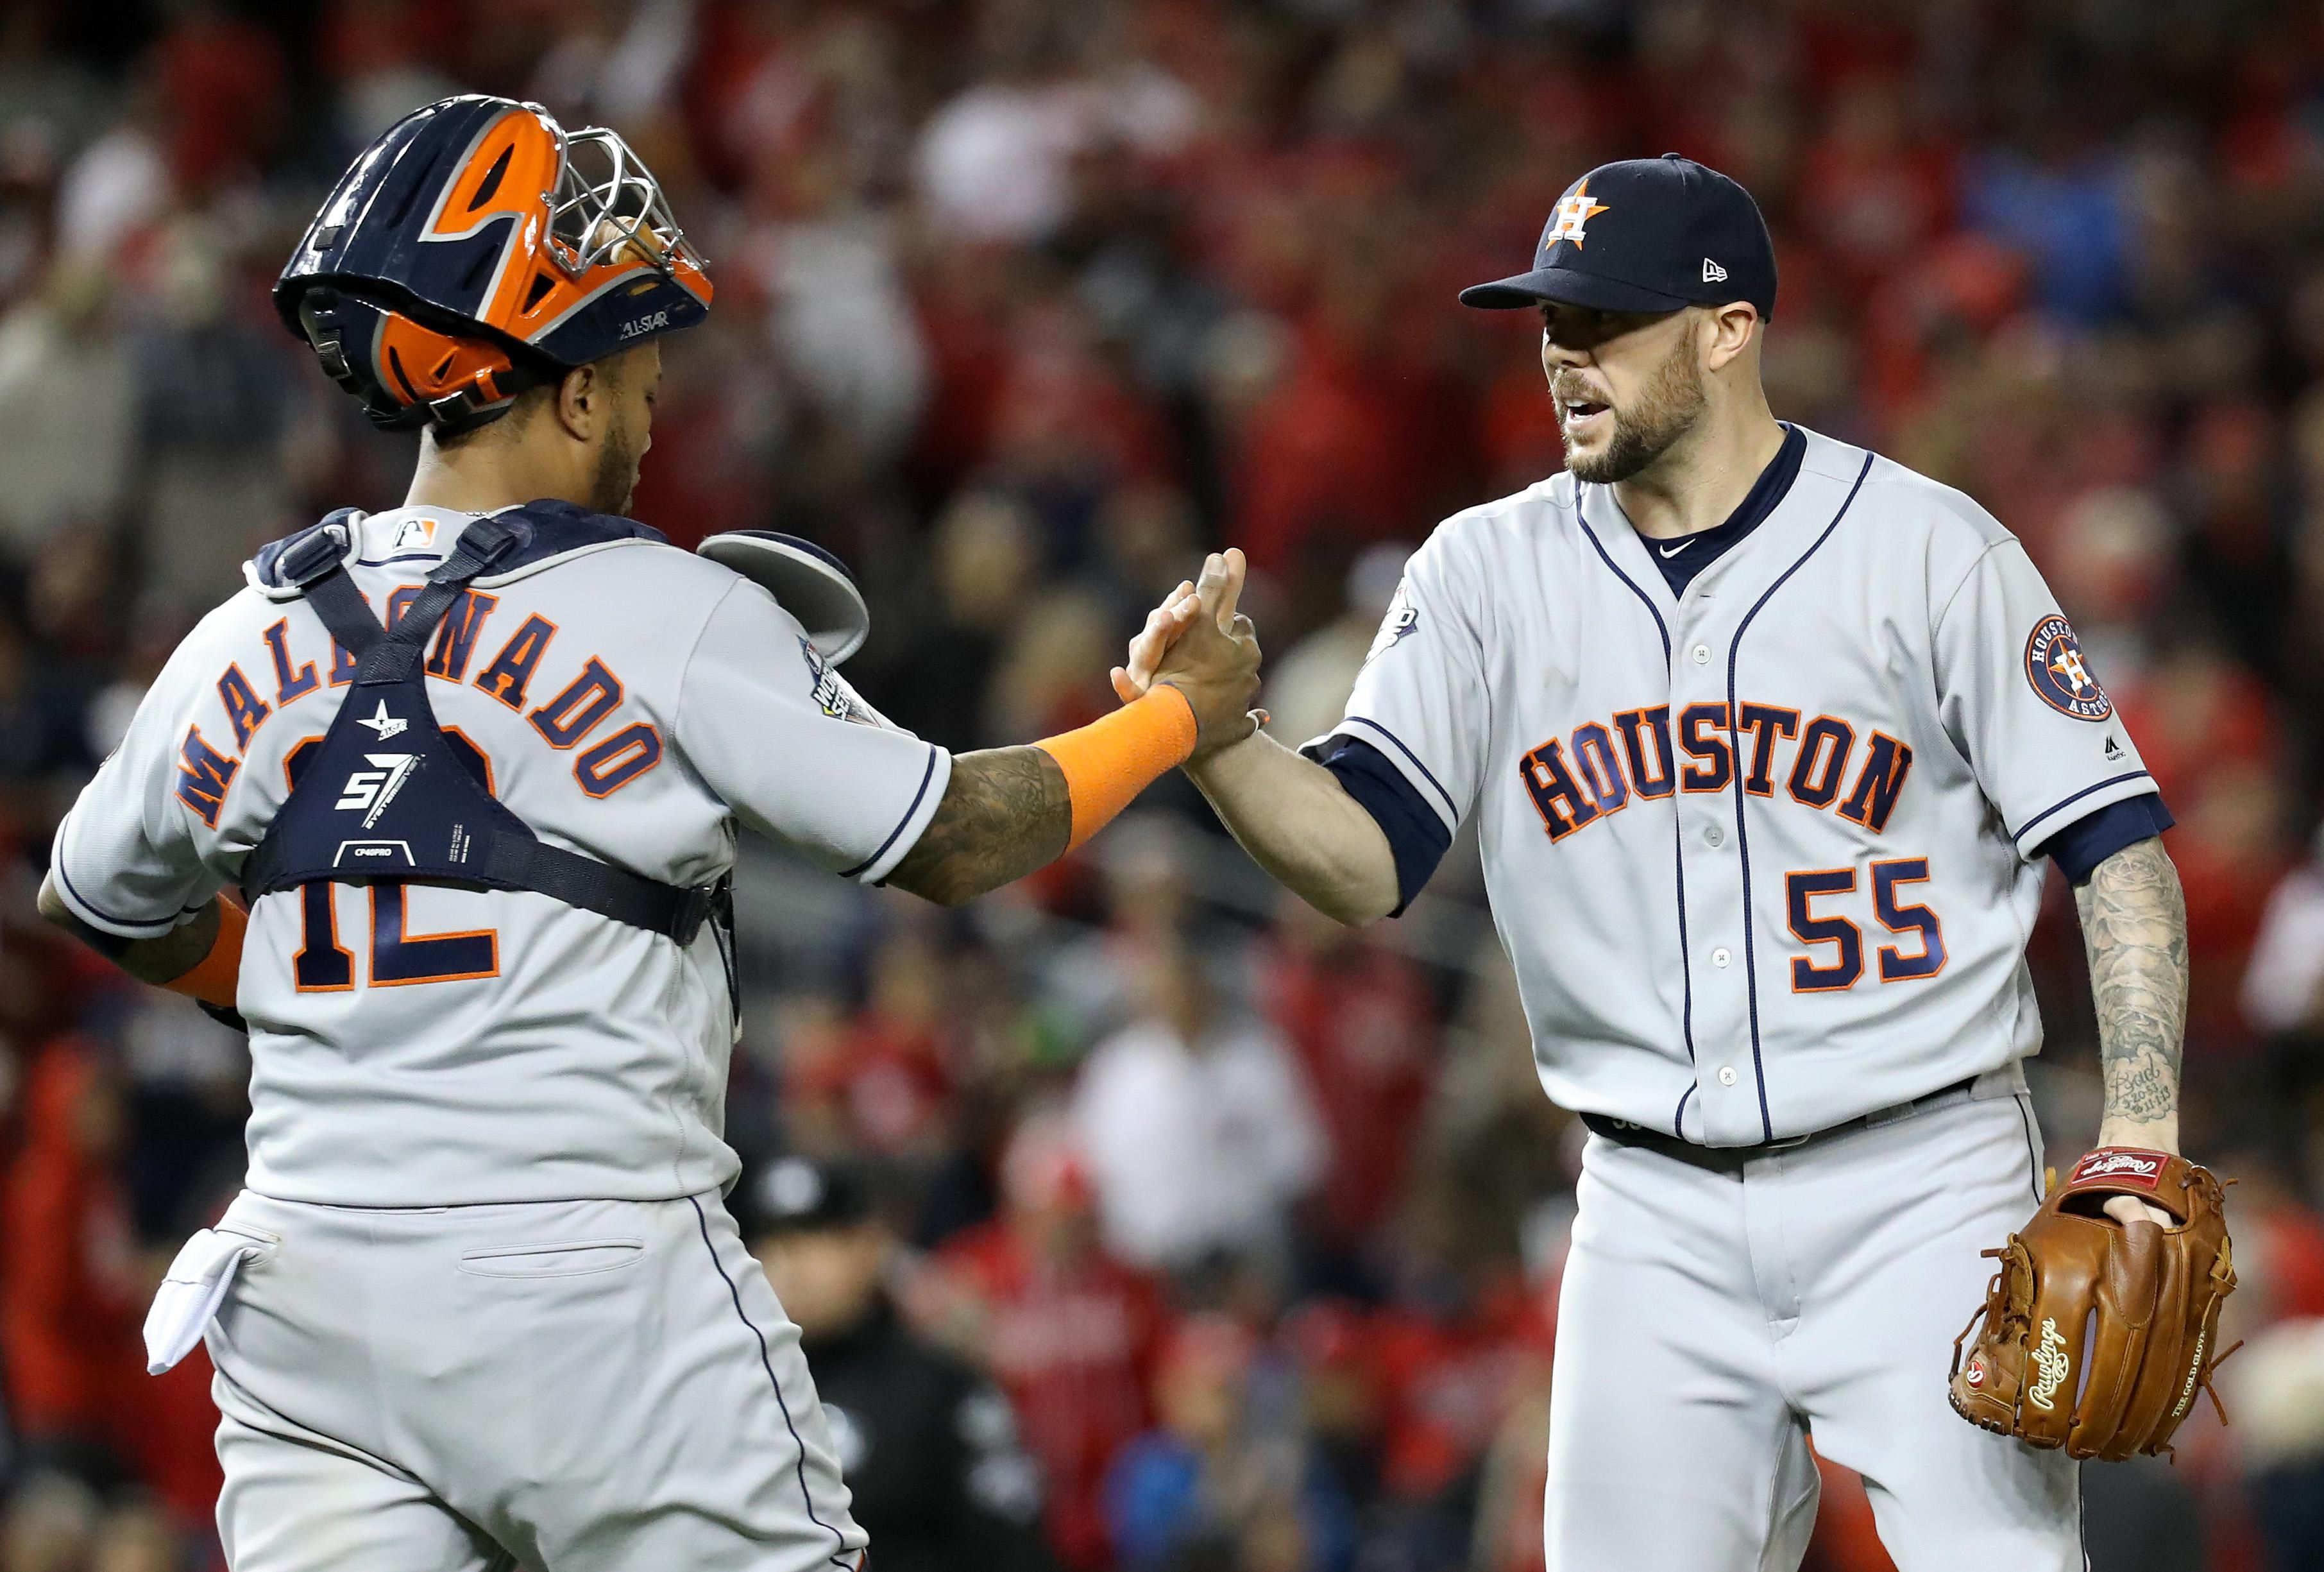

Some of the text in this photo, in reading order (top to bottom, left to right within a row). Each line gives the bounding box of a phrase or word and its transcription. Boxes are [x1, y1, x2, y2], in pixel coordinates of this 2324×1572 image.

[1548, 196, 1598, 241] H
[174, 585, 663, 830] MALNADO
[1519, 701, 1913, 844] HOUSTON
[1784, 856, 1948, 993] 55
[2028, 1317, 2066, 1410] Rawlings
